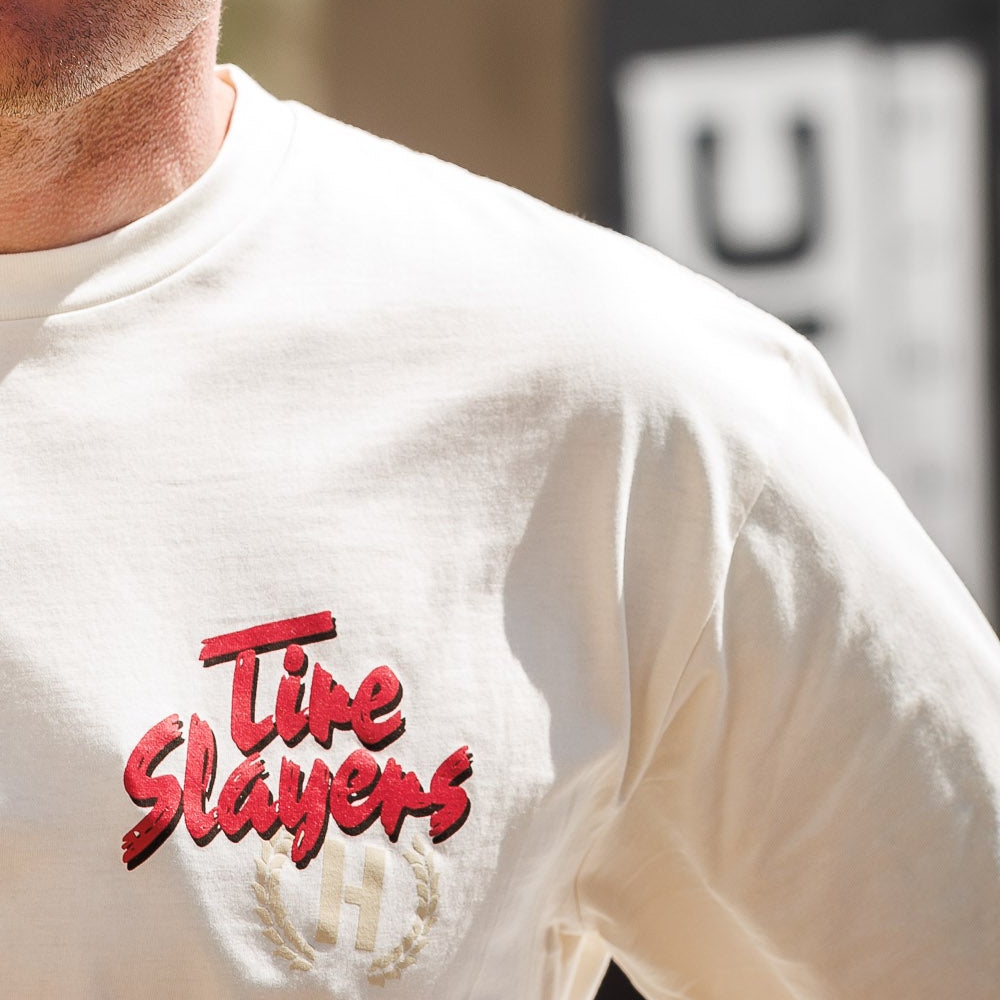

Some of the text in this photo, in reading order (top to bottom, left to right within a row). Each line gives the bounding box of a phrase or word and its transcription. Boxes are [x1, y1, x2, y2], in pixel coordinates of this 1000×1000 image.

[199, 610, 406, 756] Tire
[121, 713, 473, 870] Slayers
[315, 839, 386, 952] H
